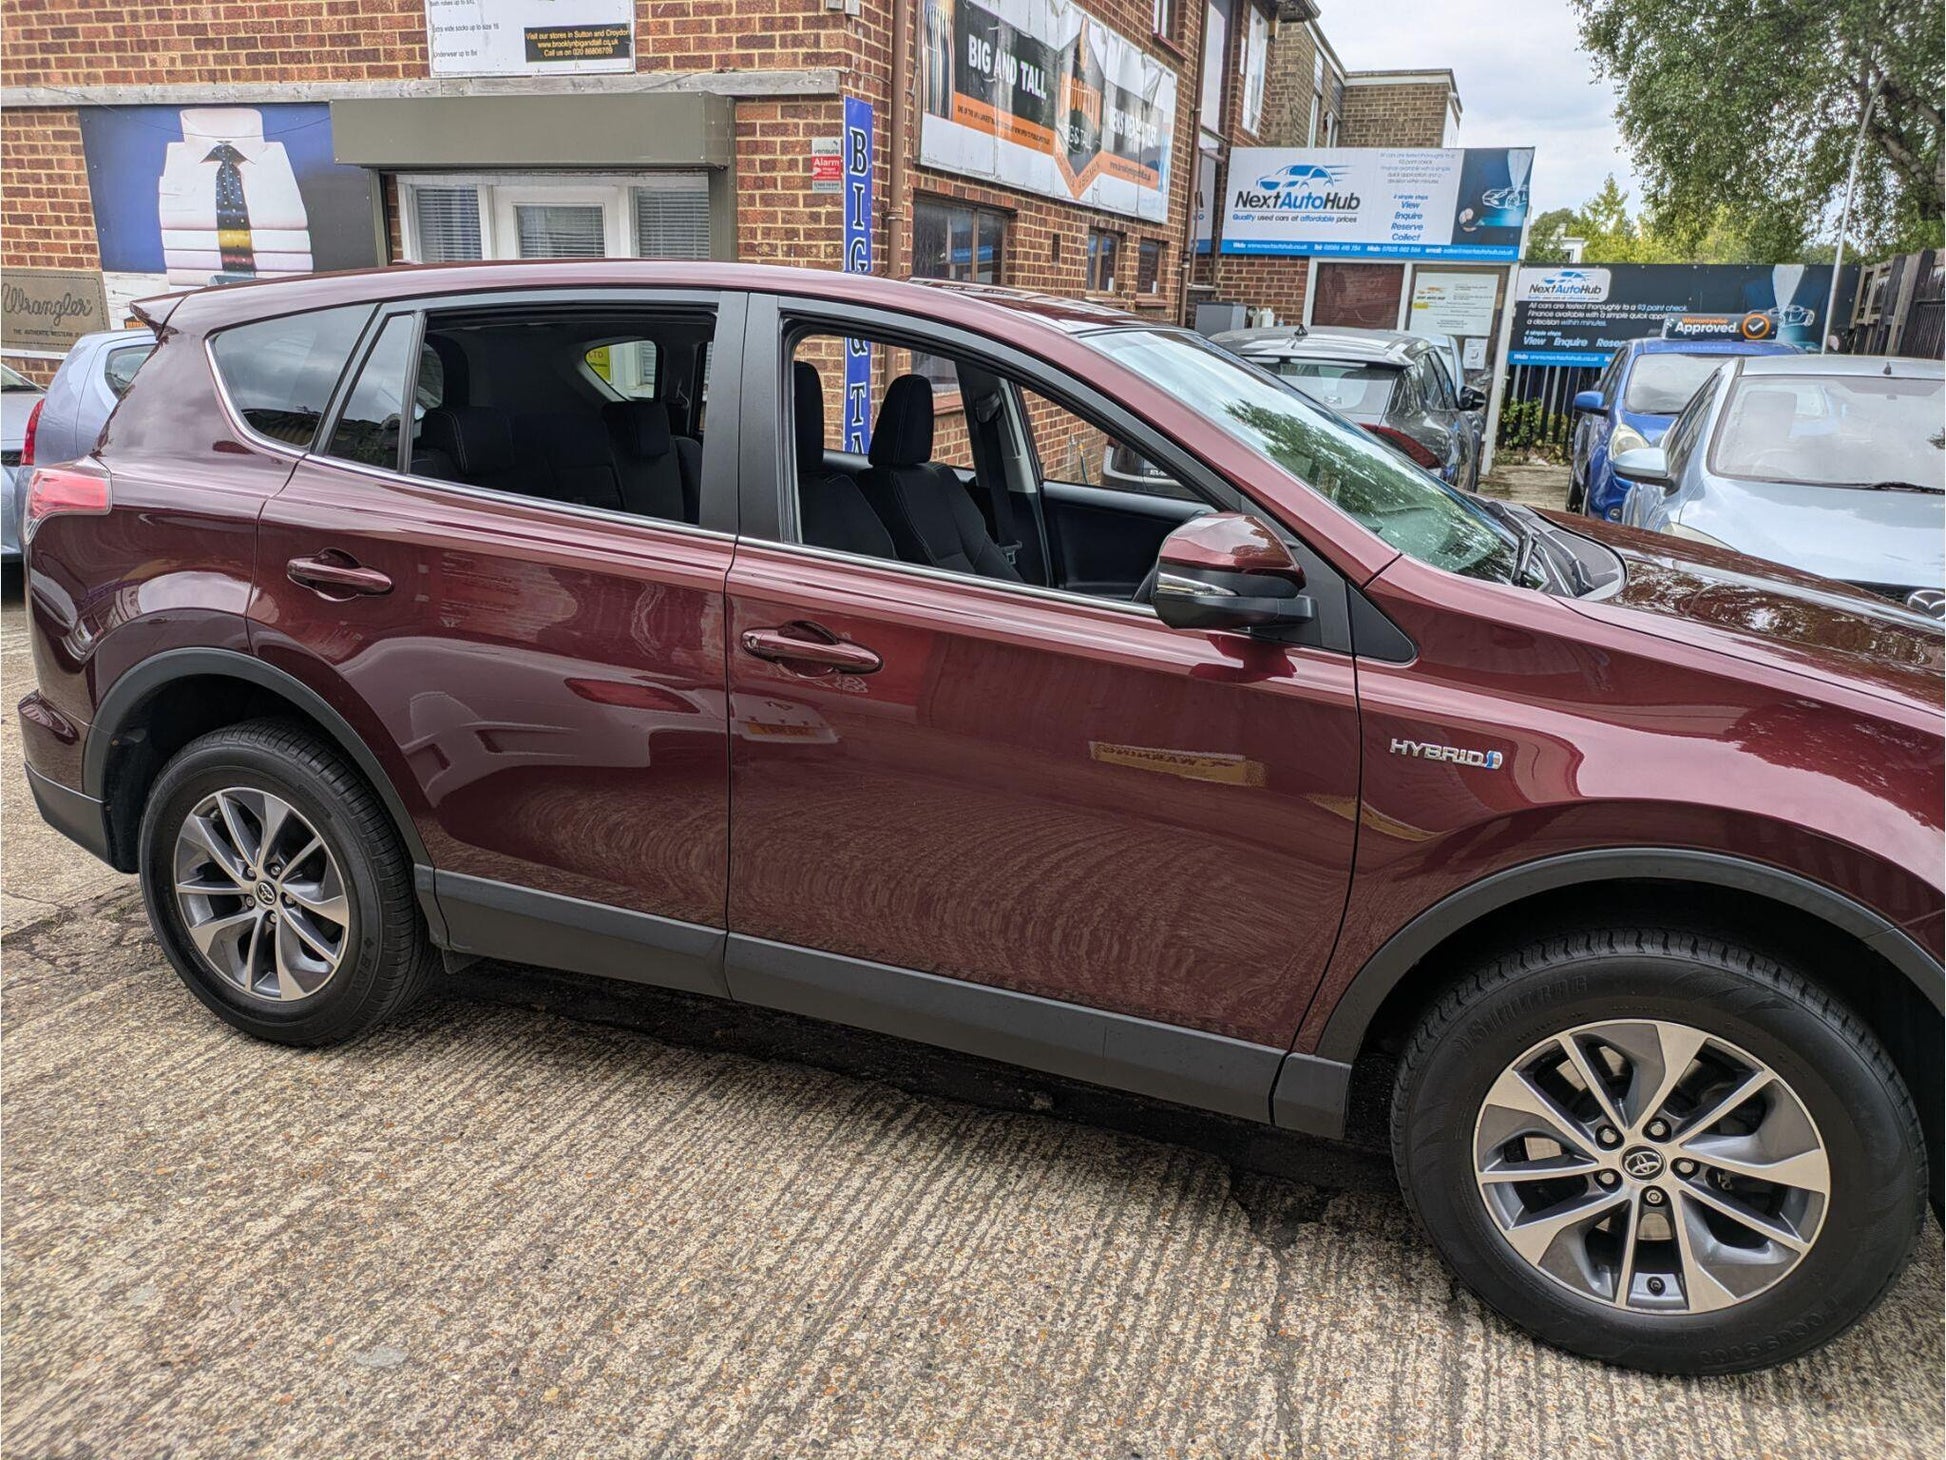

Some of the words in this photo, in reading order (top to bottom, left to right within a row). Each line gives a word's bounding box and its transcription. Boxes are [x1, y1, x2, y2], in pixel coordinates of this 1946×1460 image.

[574, 30, 593, 38] Sutton
[967, 32, 992, 75] BIG
[993, 47, 1018, 87] AND
[1020, 60, 1047, 100] TALL
[813, 157, 840, 167] Alarm
[1234, 190, 1361, 210] NextAutoHub
[1400, 201, 1421, 209] View
[1232, 213, 1256, 222] Quality
[1257, 213, 1274, 222] used
[1300, 213, 1335, 223] affordable
[1335, 215, 1357, 224] prices
[1394, 211, 1423, 221] Enquire
[1390, 222, 1424, 231] Reserve
[1391, 233, 1421, 242] Collect
[1529, 284, 1602, 294] NextAutoHub
[0, 283, 93, 326] Wrangler
[1566, 302, 1586, 310] tested
[1587, 303, 1621, 312] thoroughly
[1622, 303, 1630, 311] to
[1646, 304, 1665, 312] point
[1527, 309, 1554, 317] Finance
[1554, 310, 1584, 318] available
[1606, 312, 1628, 320] simple
[1629, 312, 1647, 320] quick
[1523, 336, 1547, 345] View
[1553, 337, 1588, 348] Enquire
[1389, 738, 1485, 767] HYBRID
